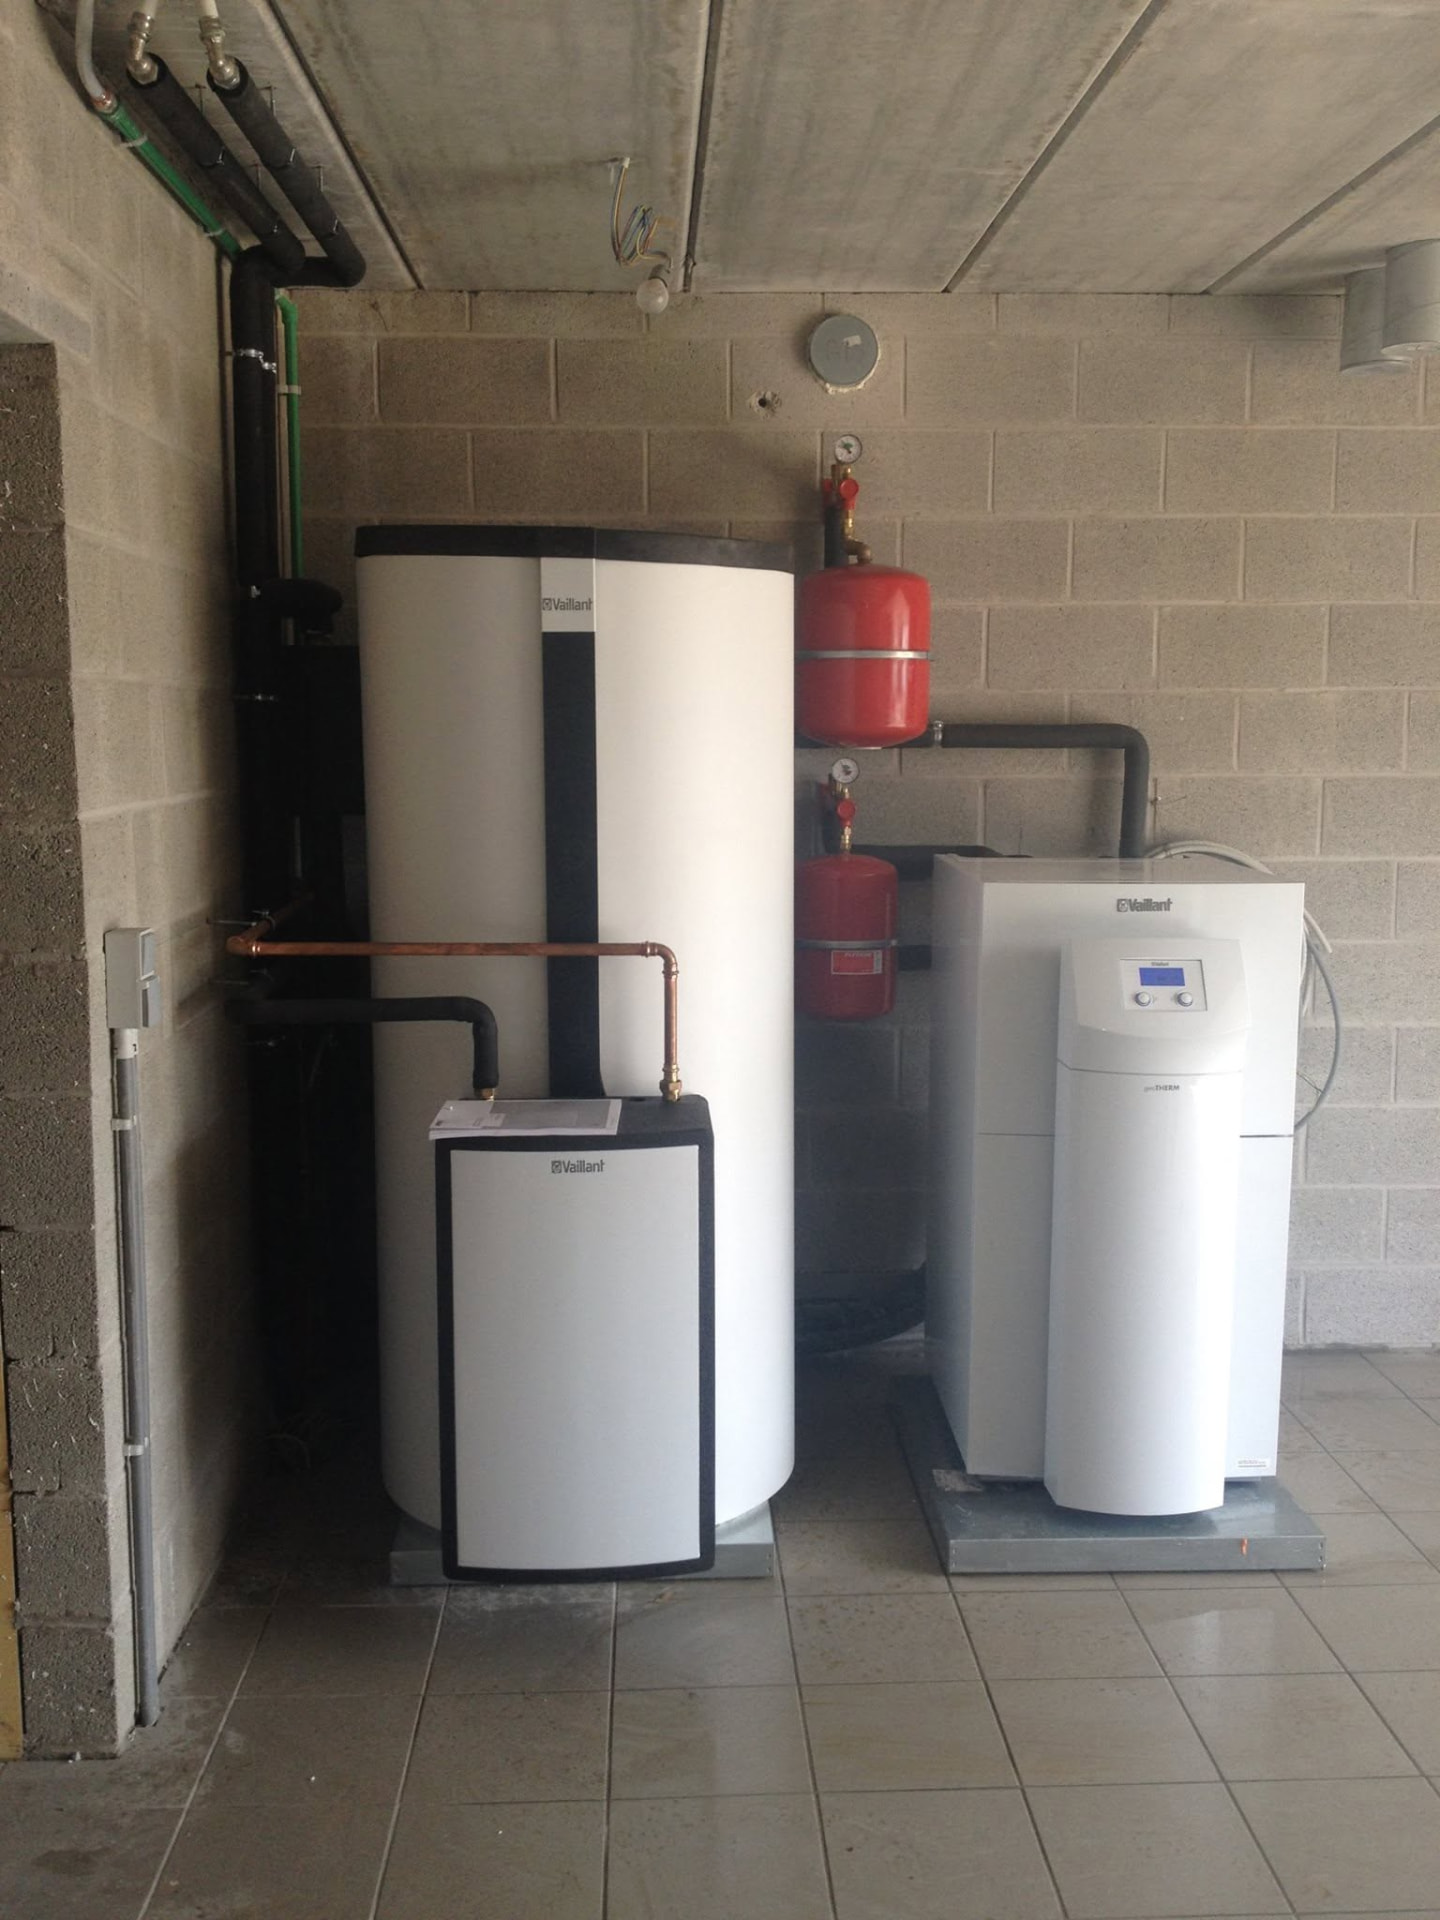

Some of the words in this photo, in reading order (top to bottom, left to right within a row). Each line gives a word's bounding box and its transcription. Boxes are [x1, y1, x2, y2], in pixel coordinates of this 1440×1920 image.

[553, 598, 593, 611] Vaillant
[1129, 898, 1173, 912] Vaillant
[562, 1159, 605, 1173] Vaillant
